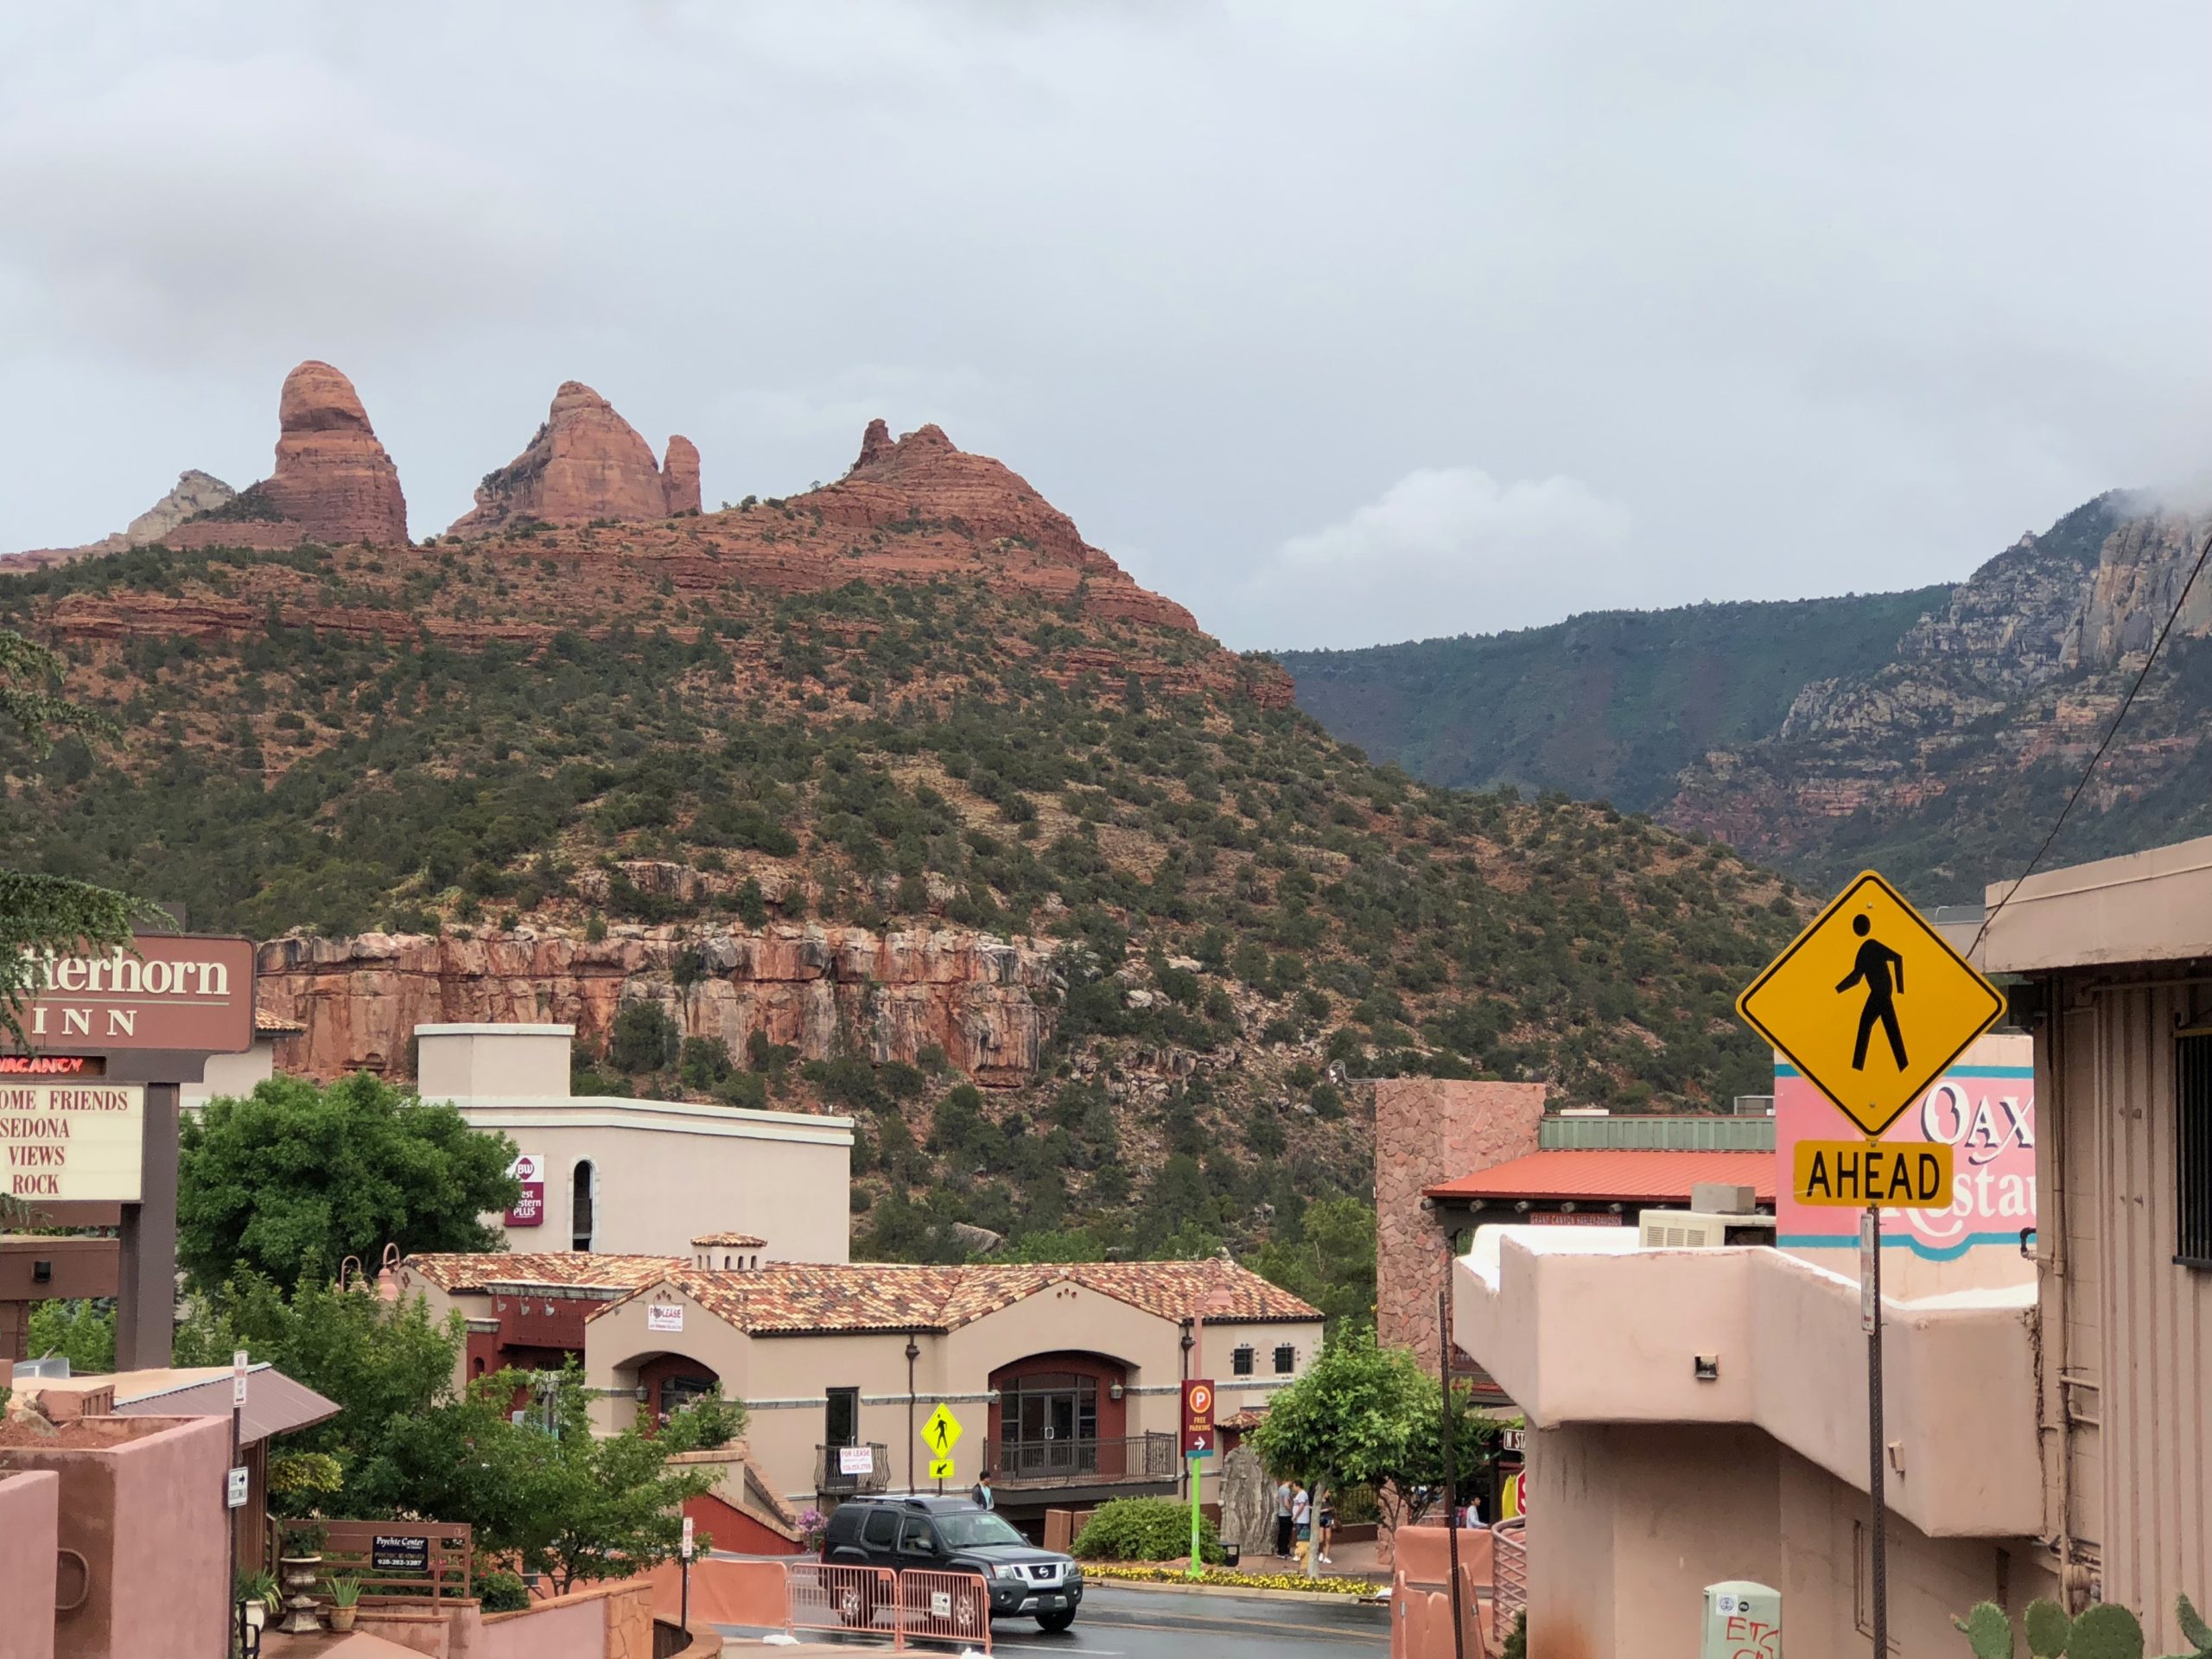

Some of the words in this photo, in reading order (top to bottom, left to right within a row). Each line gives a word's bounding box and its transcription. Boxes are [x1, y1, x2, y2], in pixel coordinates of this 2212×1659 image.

[14, 946, 230, 995] tterhorn
[32, 1007, 137, 1036] INN
[49, 1090, 128, 1110] FRIENDS
[0, 1117, 70, 1138] SEDONA
[9, 1146, 65, 1166] VIEWS
[518, 1164, 533, 1174] BW
[1806, 1151, 1941, 1200] AHEAD
[12, 1174, 60, 1194] ROCK
[513, 1207, 536, 1217] PLUS
[663, 1308, 681, 1319] LEASE
[1196, 1392, 1205, 1408] P
[1506, 1432, 1513, 1448] N
[377, 1537, 401, 1548] Psychic
